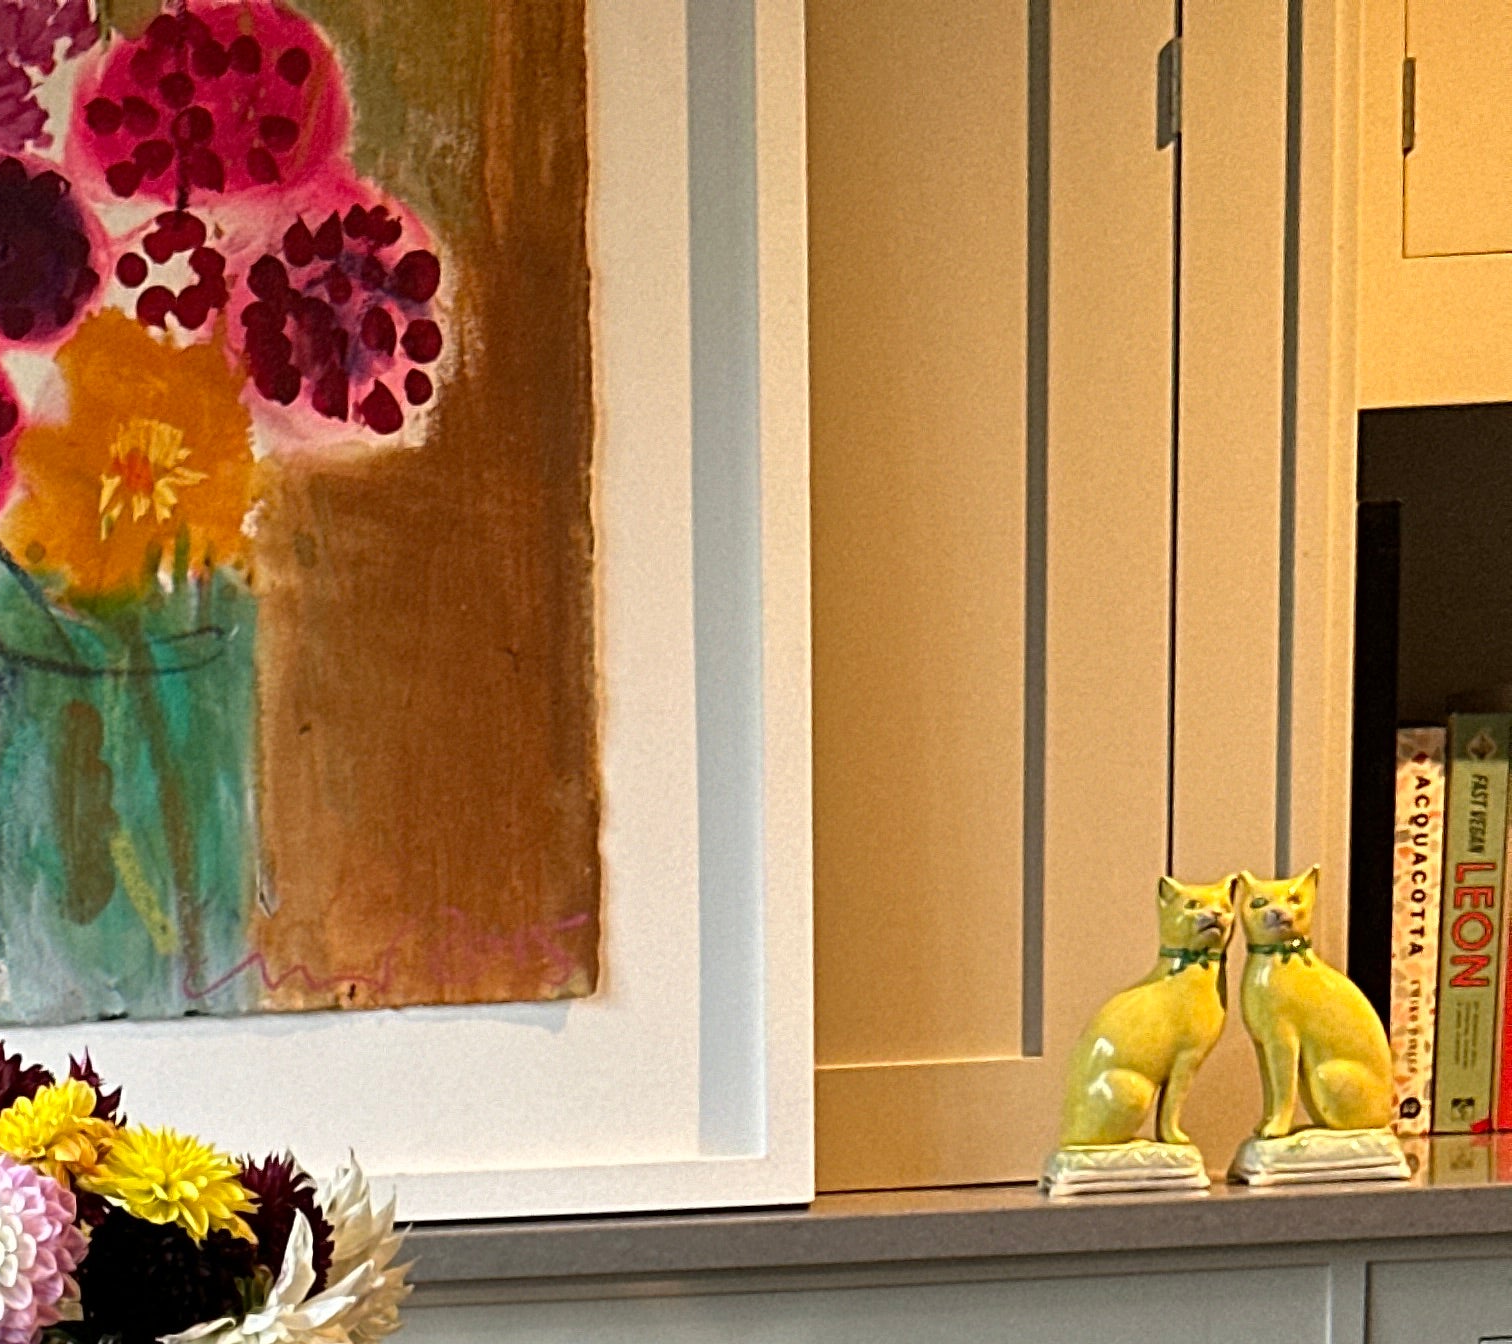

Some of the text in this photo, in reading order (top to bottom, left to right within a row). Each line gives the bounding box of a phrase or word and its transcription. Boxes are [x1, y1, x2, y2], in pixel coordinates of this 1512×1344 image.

[1408, 775, 1432, 957] ACQUACOTTA
[1467, 774, 1489, 853] FAST VEGAN
[1449, 861, 1496, 989] LEON
